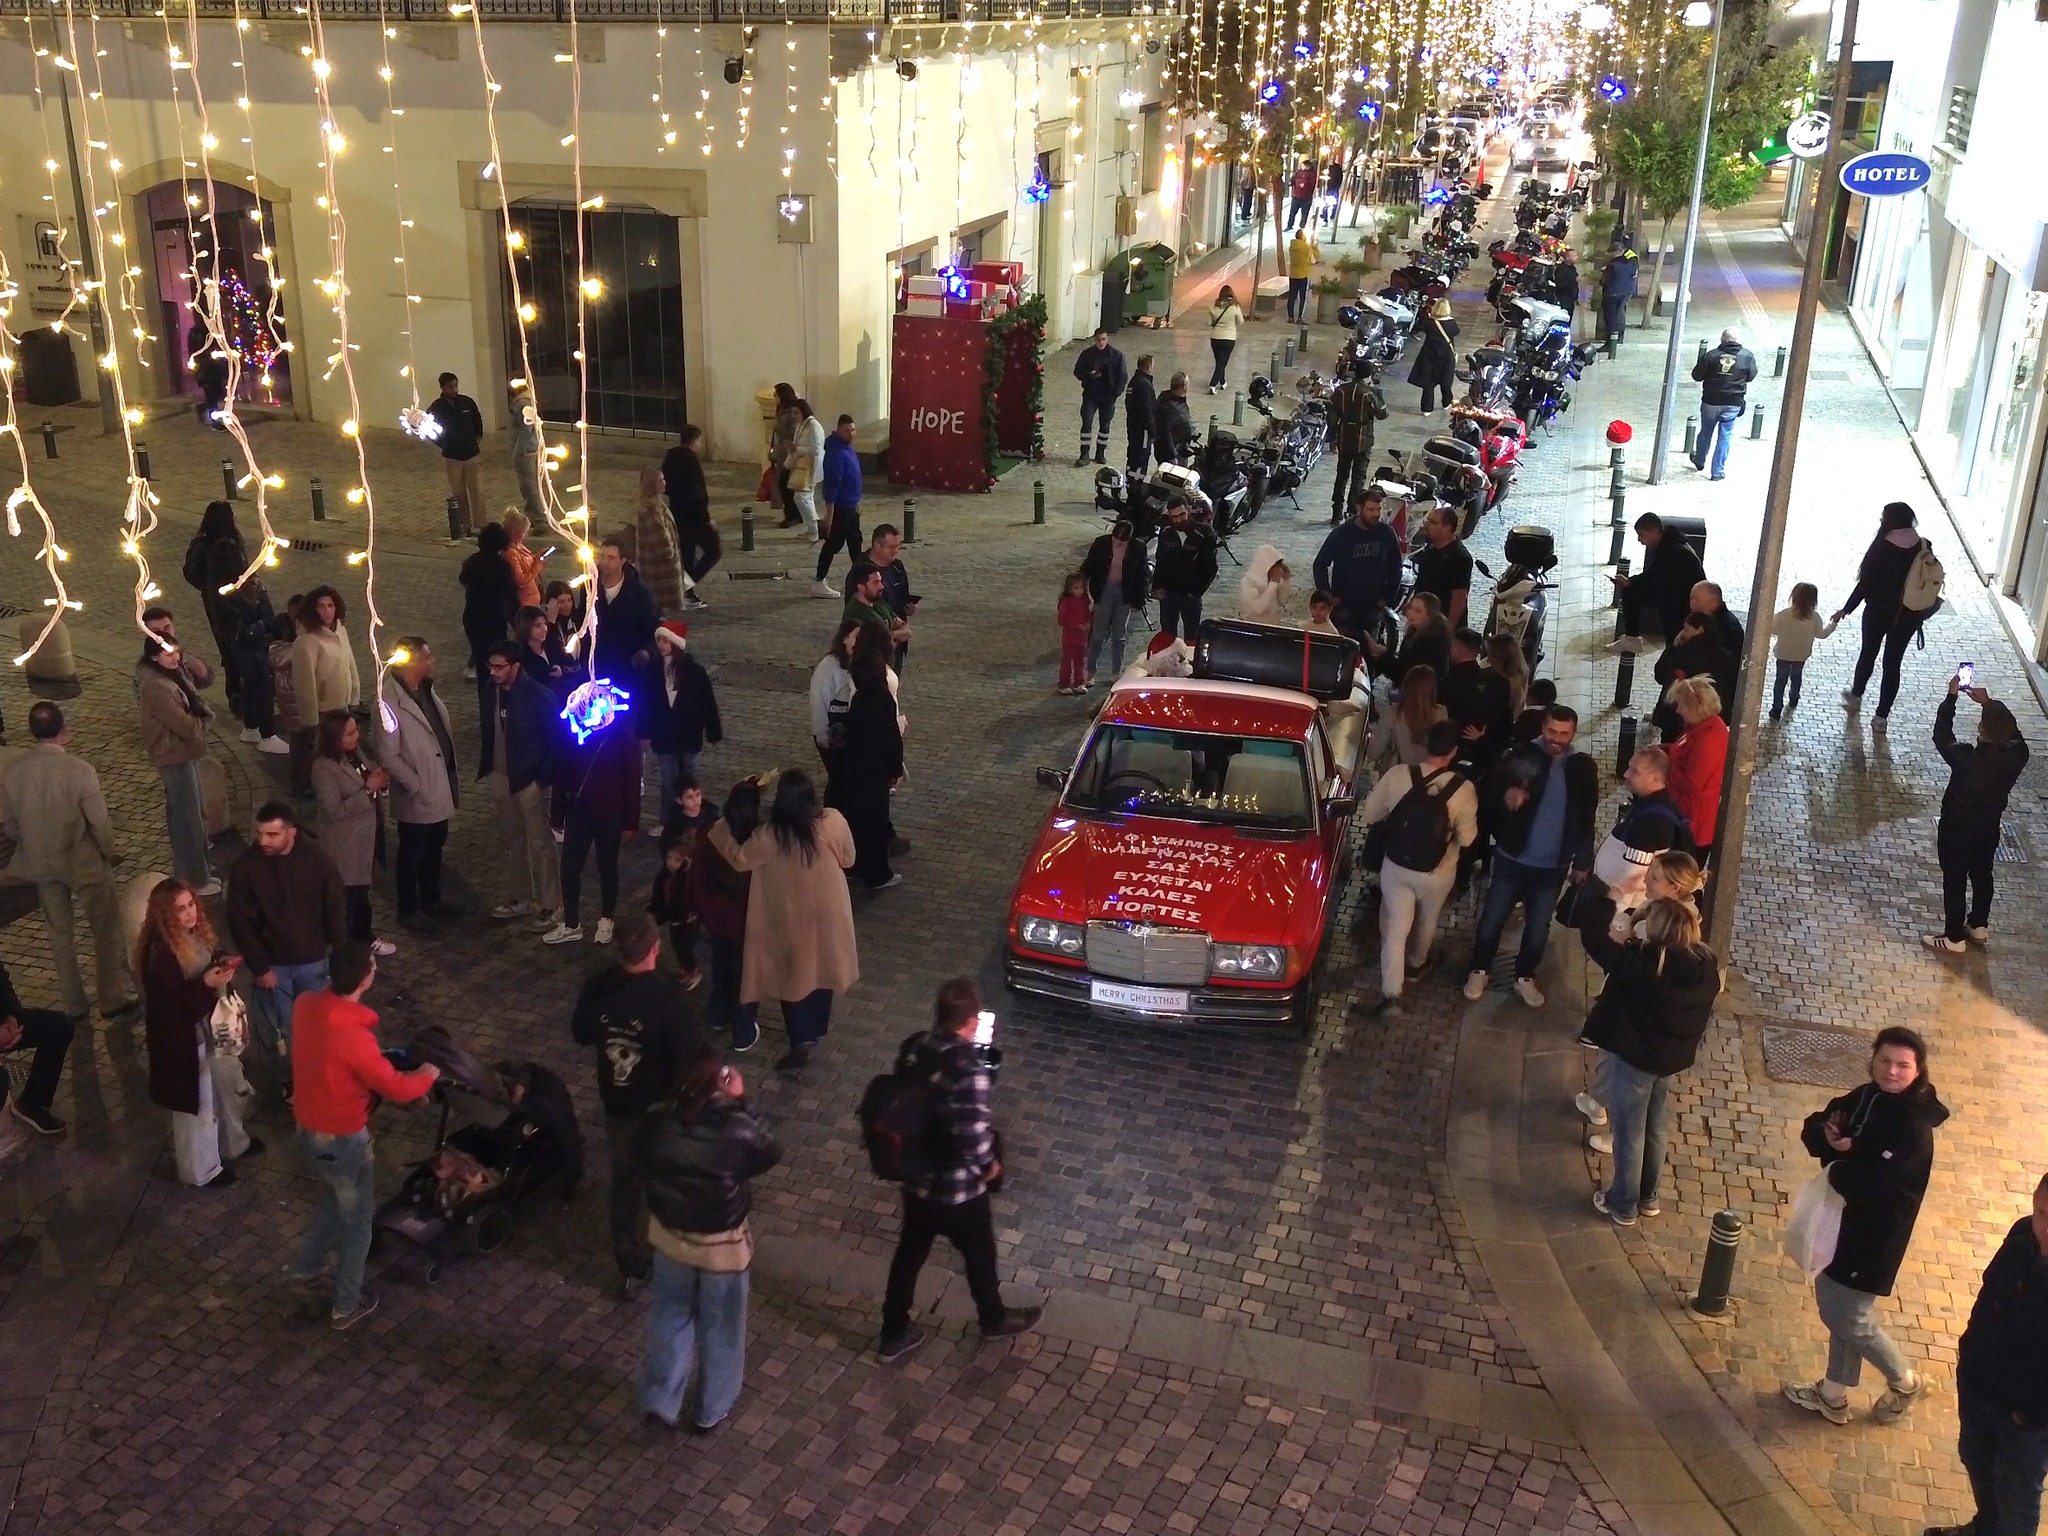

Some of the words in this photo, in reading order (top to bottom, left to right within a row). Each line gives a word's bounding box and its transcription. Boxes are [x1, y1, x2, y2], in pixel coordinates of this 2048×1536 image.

[1853, 167, 1921, 182] HOTEL
[910, 406, 965, 435] HOPE
[1145, 860, 1191, 873] ΣΑΣ
[1113, 871, 1213, 892] ΕΥΧΕΤΑΙ
[1118, 885, 1197, 905] ΚΑΛΕΣ
[1102, 900, 1201, 923] ΓΙΟΡΤΕΣ
[1098, 987, 1126, 1000] MERRY
[1129, 992, 1180, 1006] CHRISTMAS
